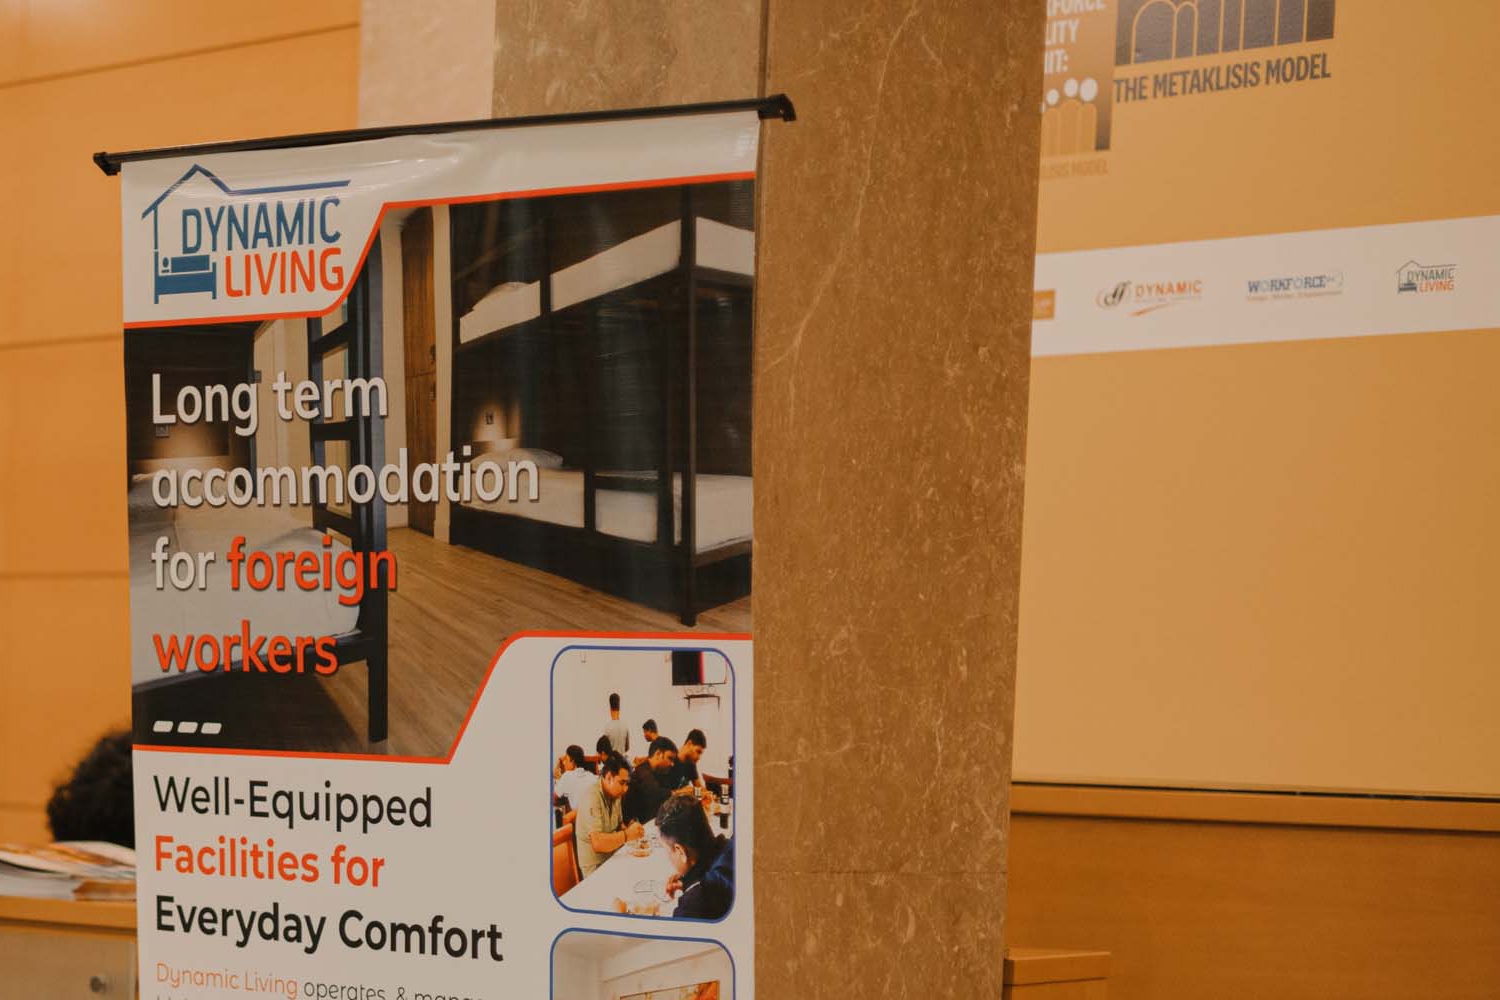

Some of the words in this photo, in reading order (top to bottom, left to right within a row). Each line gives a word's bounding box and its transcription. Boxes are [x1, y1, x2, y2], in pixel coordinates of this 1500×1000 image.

[1114, 76, 1148, 103] THE
[1153, 61, 1260, 98] METAKLISIS
[1265, 52, 1331, 84] MODEL
[182, 196, 341, 254] DYNAMIC
[225, 248, 344, 297] LIVING
[1135, 280, 1202, 297] DYNAMIC
[1407, 267, 1456, 282] DYNAMIC
[1419, 277, 1455, 293] LIVING
[152, 373, 258, 436] Long
[272, 371, 388, 421] term
[152, 445, 540, 507] accommodation
[151, 536, 215, 590] for
[227, 535, 397, 605] foreign
[153, 620, 338, 675] workers
[153, 775, 432, 833] Well-Equipped
[155, 835, 320, 883] Facilities
[331, 844, 385, 887] for
[156, 895, 327, 954] Everyday
[339, 909, 503, 961] Comfort
[156, 962, 239, 989] Dynamic
[244, 971, 298, 1000] Living
